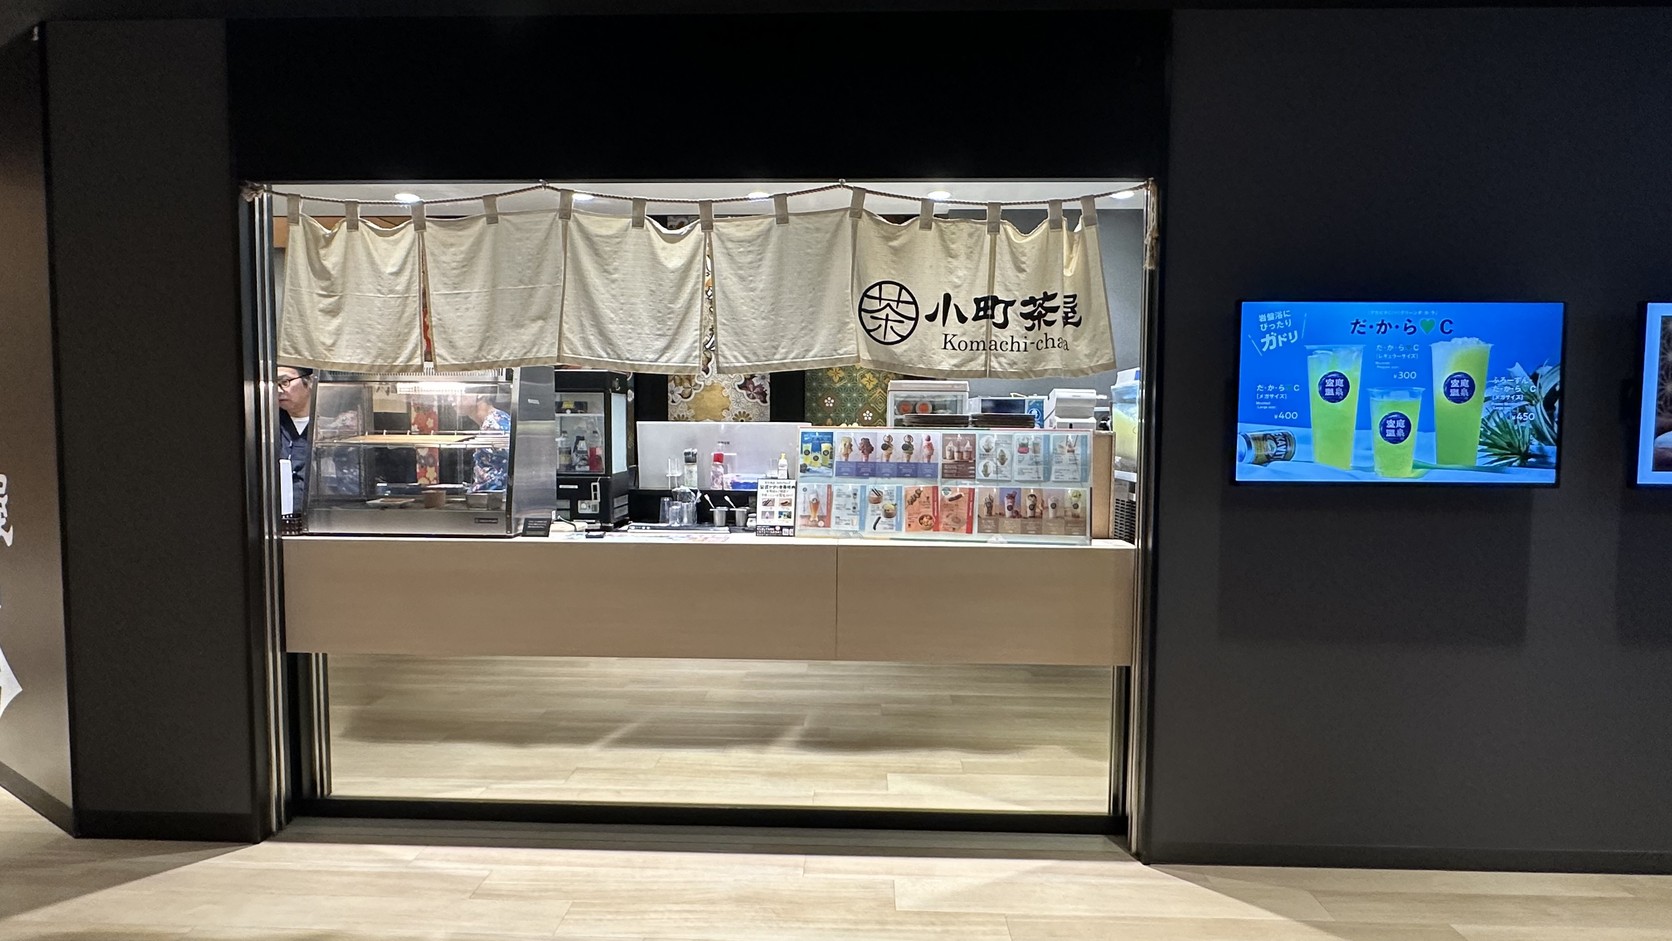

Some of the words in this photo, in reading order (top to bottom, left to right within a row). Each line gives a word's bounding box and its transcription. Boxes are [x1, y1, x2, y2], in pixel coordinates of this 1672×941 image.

[858, 280, 919, 345] 茶
[1258, 309, 1292, 322] 岩盤浴に
[1260, 330, 1299, 352] ガドリ
